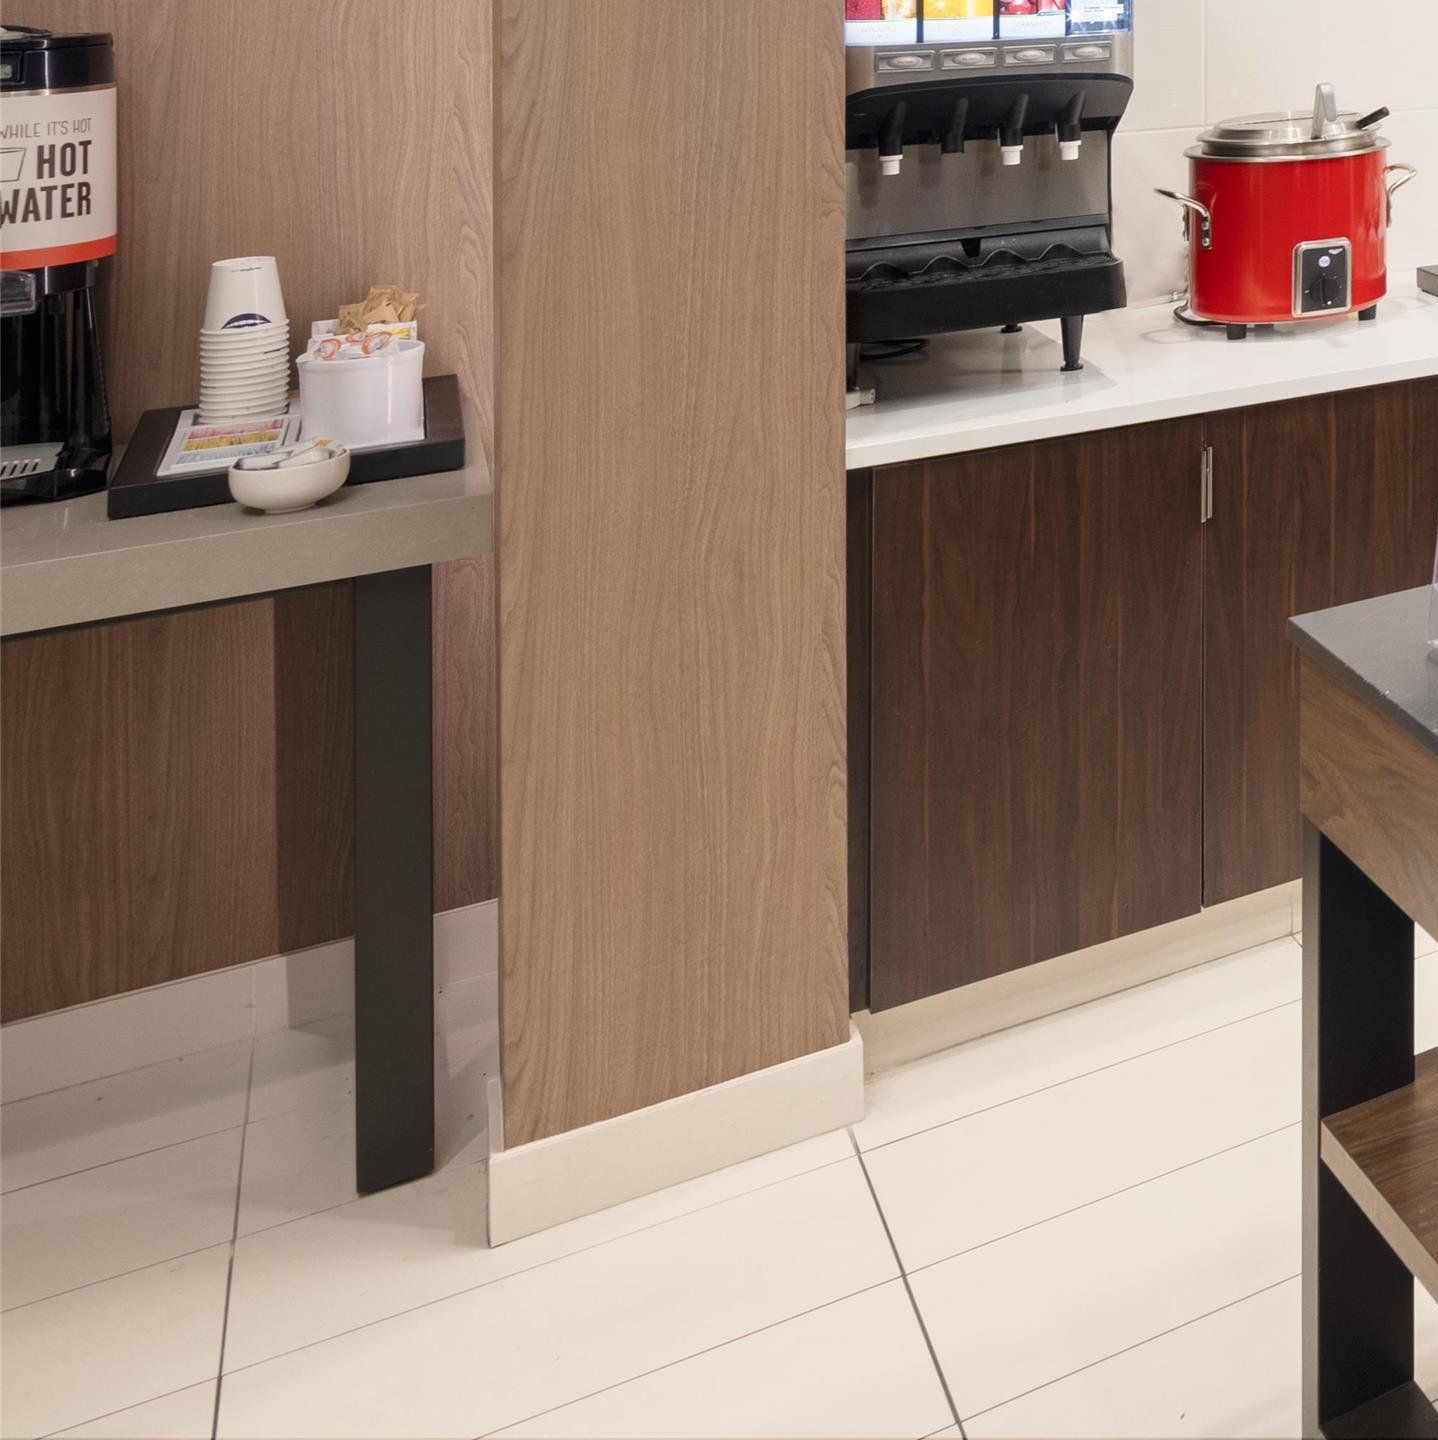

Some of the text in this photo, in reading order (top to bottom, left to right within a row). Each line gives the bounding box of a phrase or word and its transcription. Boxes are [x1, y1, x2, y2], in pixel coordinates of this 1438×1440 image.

[47, 120, 69, 136] IT'S
[73, 117, 93, 133] HOT
[37, 140, 92, 179] HOT
